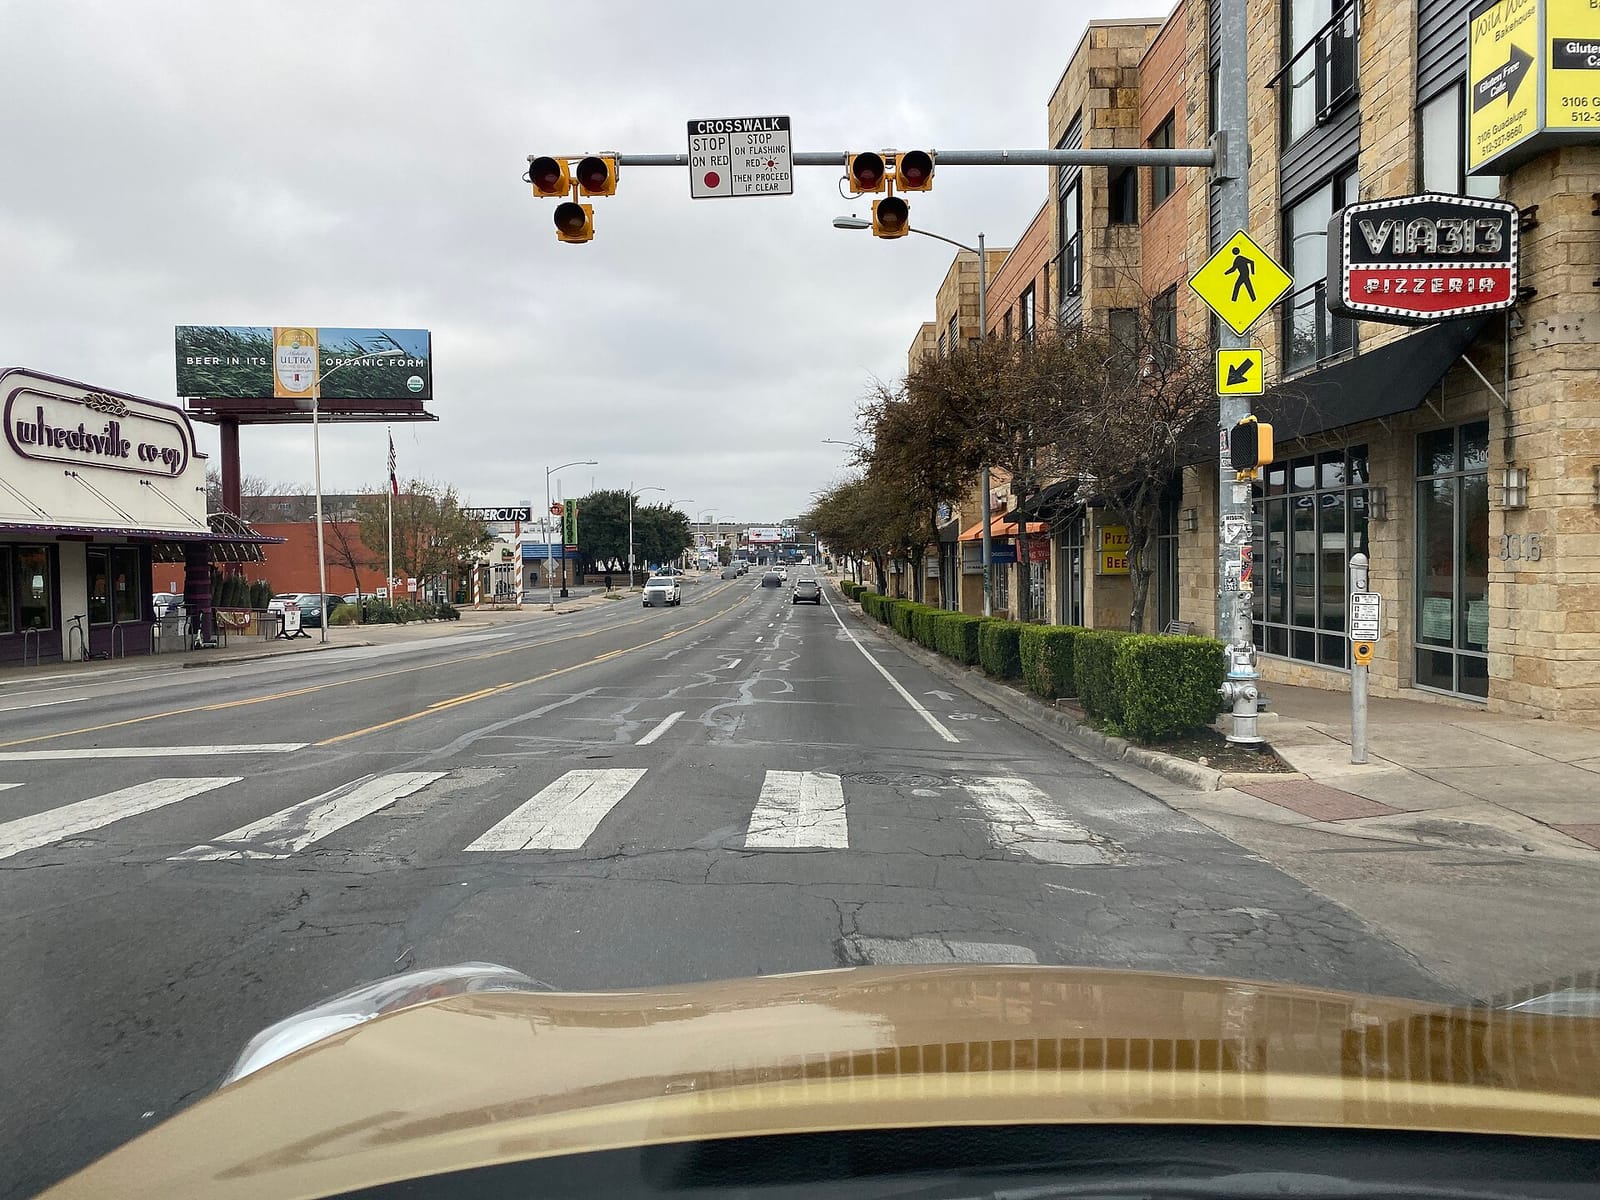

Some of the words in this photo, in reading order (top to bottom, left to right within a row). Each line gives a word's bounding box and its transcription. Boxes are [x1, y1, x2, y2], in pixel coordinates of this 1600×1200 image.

[1495, 6, 1536, 41] Bakehouse
[1480, 73, 1502, 94] Gluten
[1503, 61, 1520, 78] Free
[1562, 97, 1588, 107] 3106
[697, 118, 780, 134] CROSSWALK
[1477, 129, 1491, 145] 3106
[1492, 108, 1528, 134] Guadalupe
[693, 137, 726, 151] STOP
[747, 133, 772, 144] STOP
[734, 147, 746, 155] ON
[749, 145, 786, 154] FLASHING
[692, 157, 706, 167] ON
[710, 155, 729, 166] RED
[745, 159, 761, 167] RED
[733, 174, 752, 182] THEN
[755, 172, 789, 181] PROCEED
[745, 184, 751, 192] IF
[755, 183, 779, 191] CLEAR
[1365, 277, 1495, 294] PIZZERIA
[186, 357, 220, 365] BEER
[226, 357, 240, 365] IN
[247, 357, 266, 365] ITS
[325, 358, 384, 367] ORGANIC
[389, 359, 424, 367] FORM
[280, 356, 312, 364] ULTRA
[16, 406, 131, 458] wheatsville
[138, 443, 181, 473] co-op
[463, 508, 528, 521] SUPERCUTS
[1105, 532, 1131, 545] PIZZ
[1499, 533, 1541, 561] 3016
[1107, 556, 1128, 568] BEE
